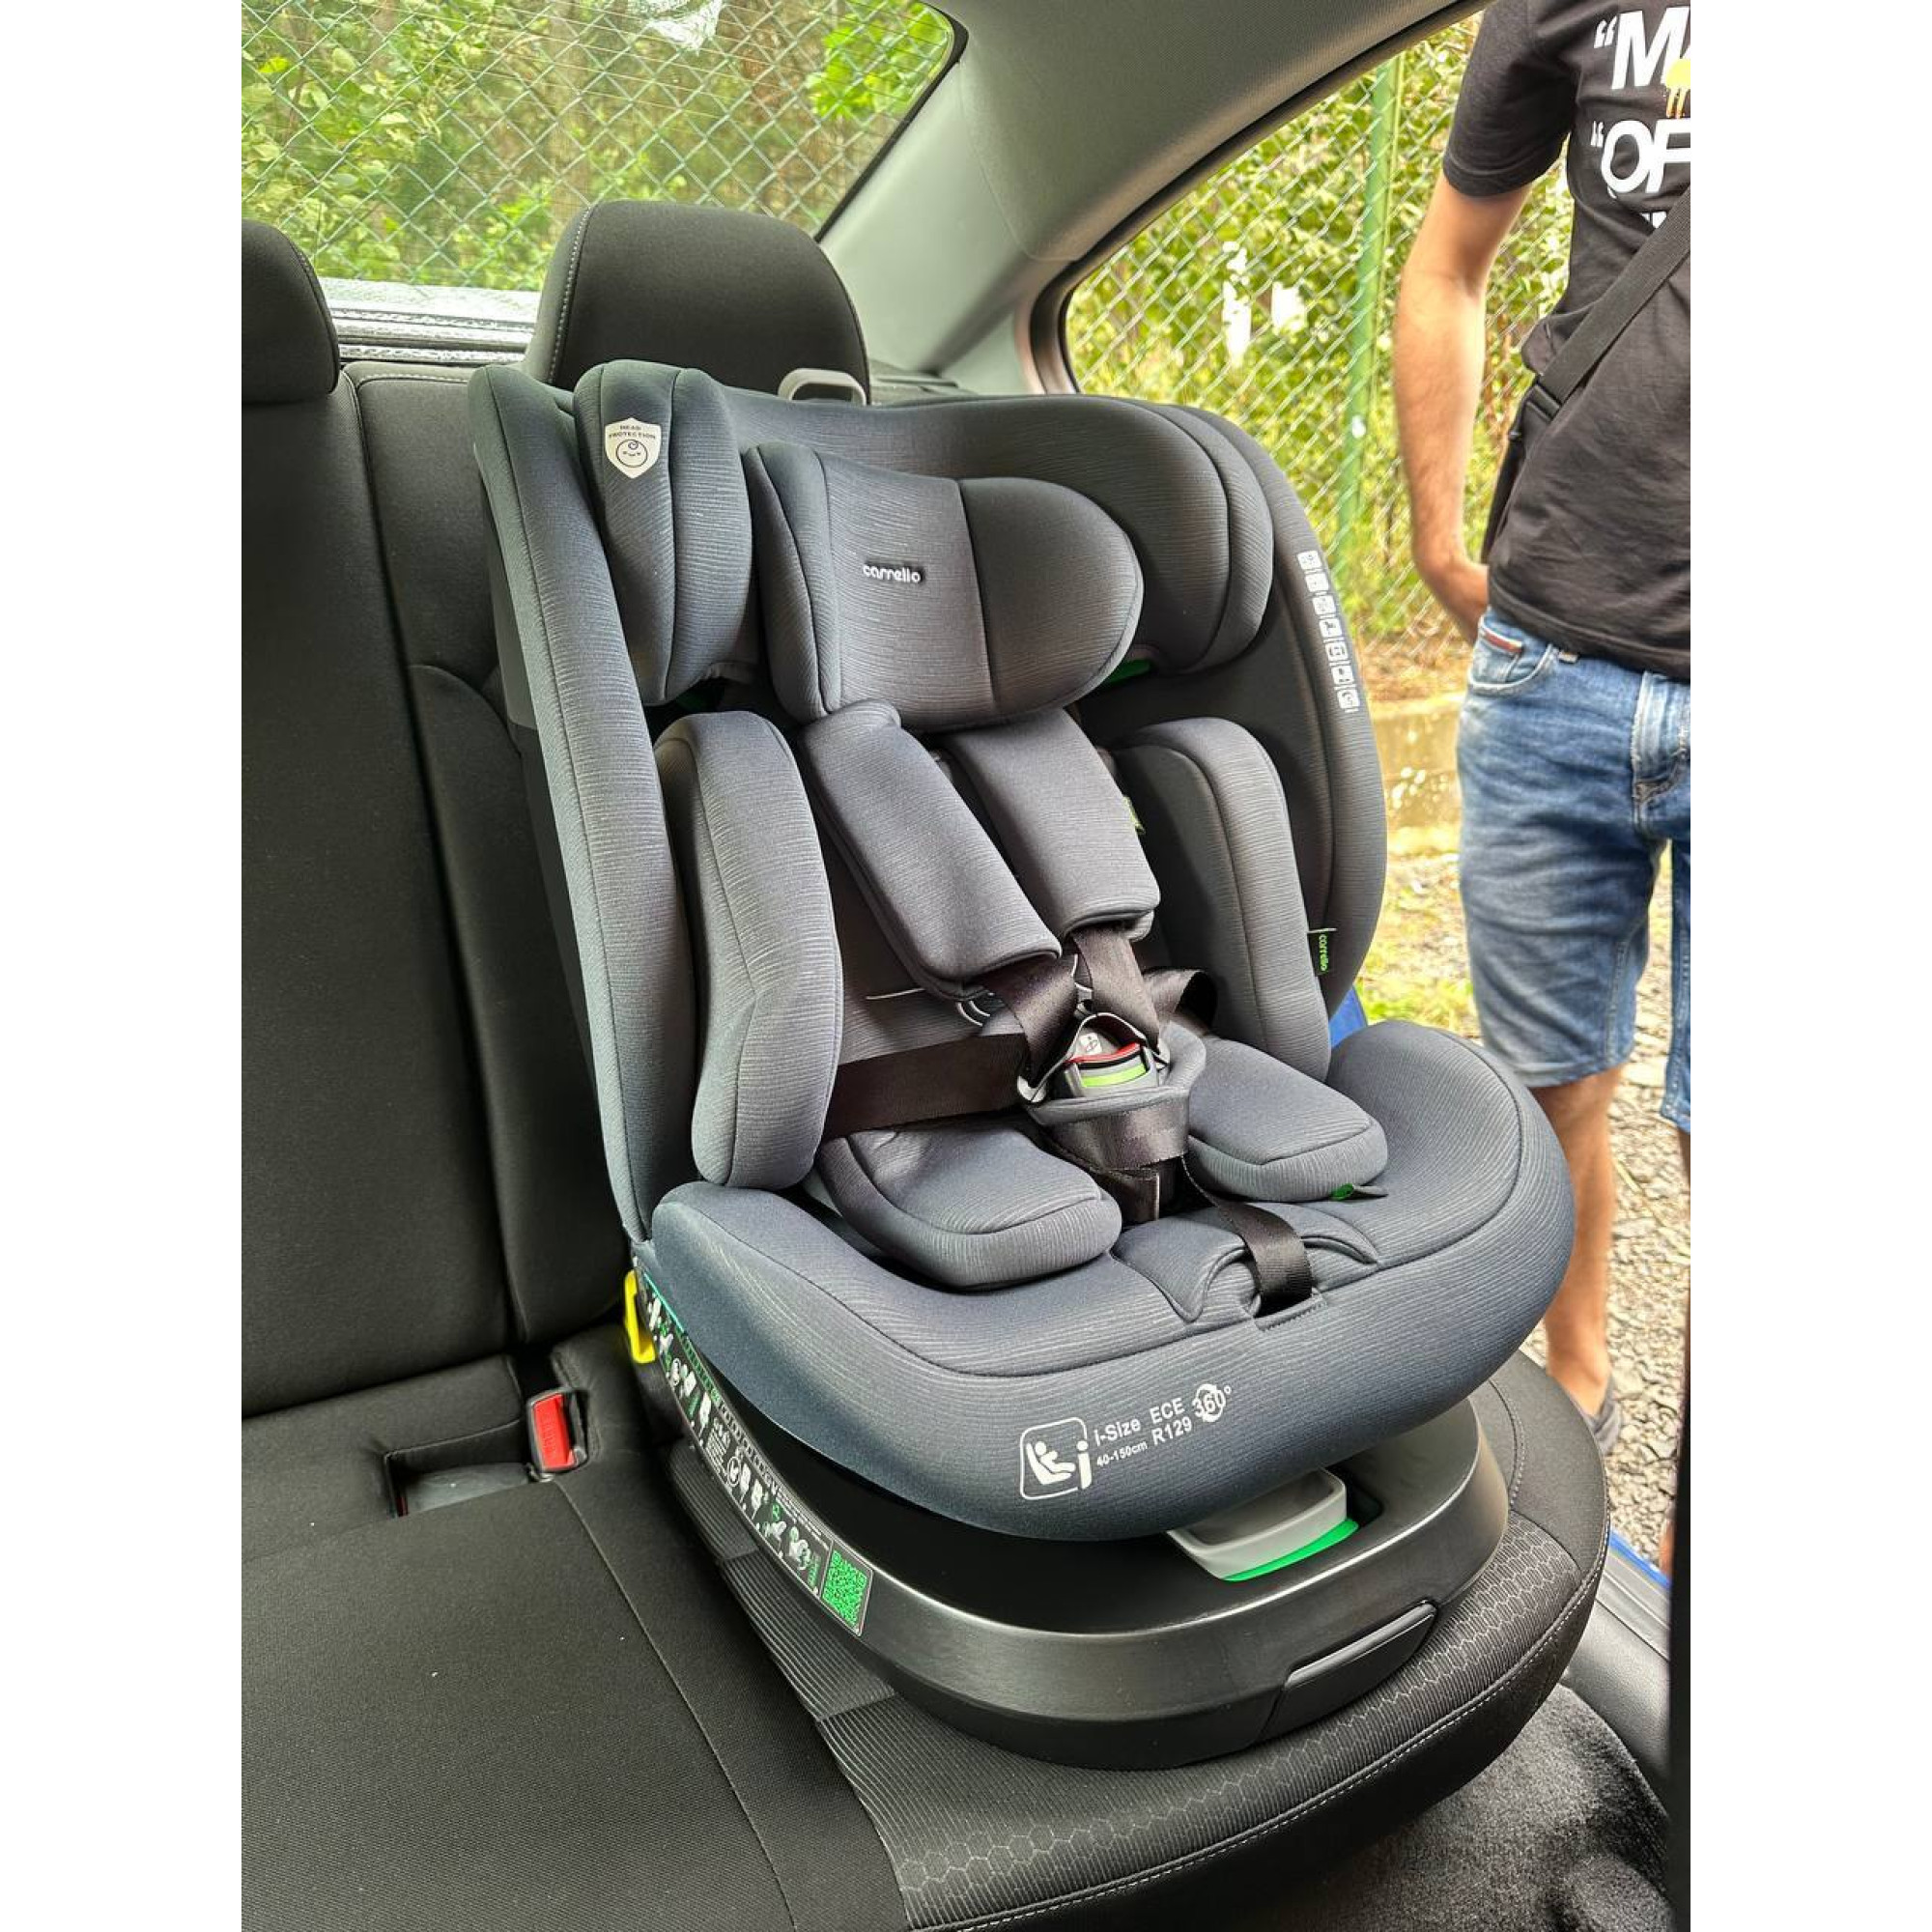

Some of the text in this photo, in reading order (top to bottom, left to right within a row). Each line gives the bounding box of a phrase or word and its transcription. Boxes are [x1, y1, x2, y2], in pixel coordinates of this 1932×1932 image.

[863, 564, 922, 583] carrello
[1149, 1397, 1185, 1425] ECE
[1094, 1418, 1142, 1447] i-Size
[1151, 1416, 1193, 1446] R129
[1096, 1440, 1148, 1466] 40-150cm
